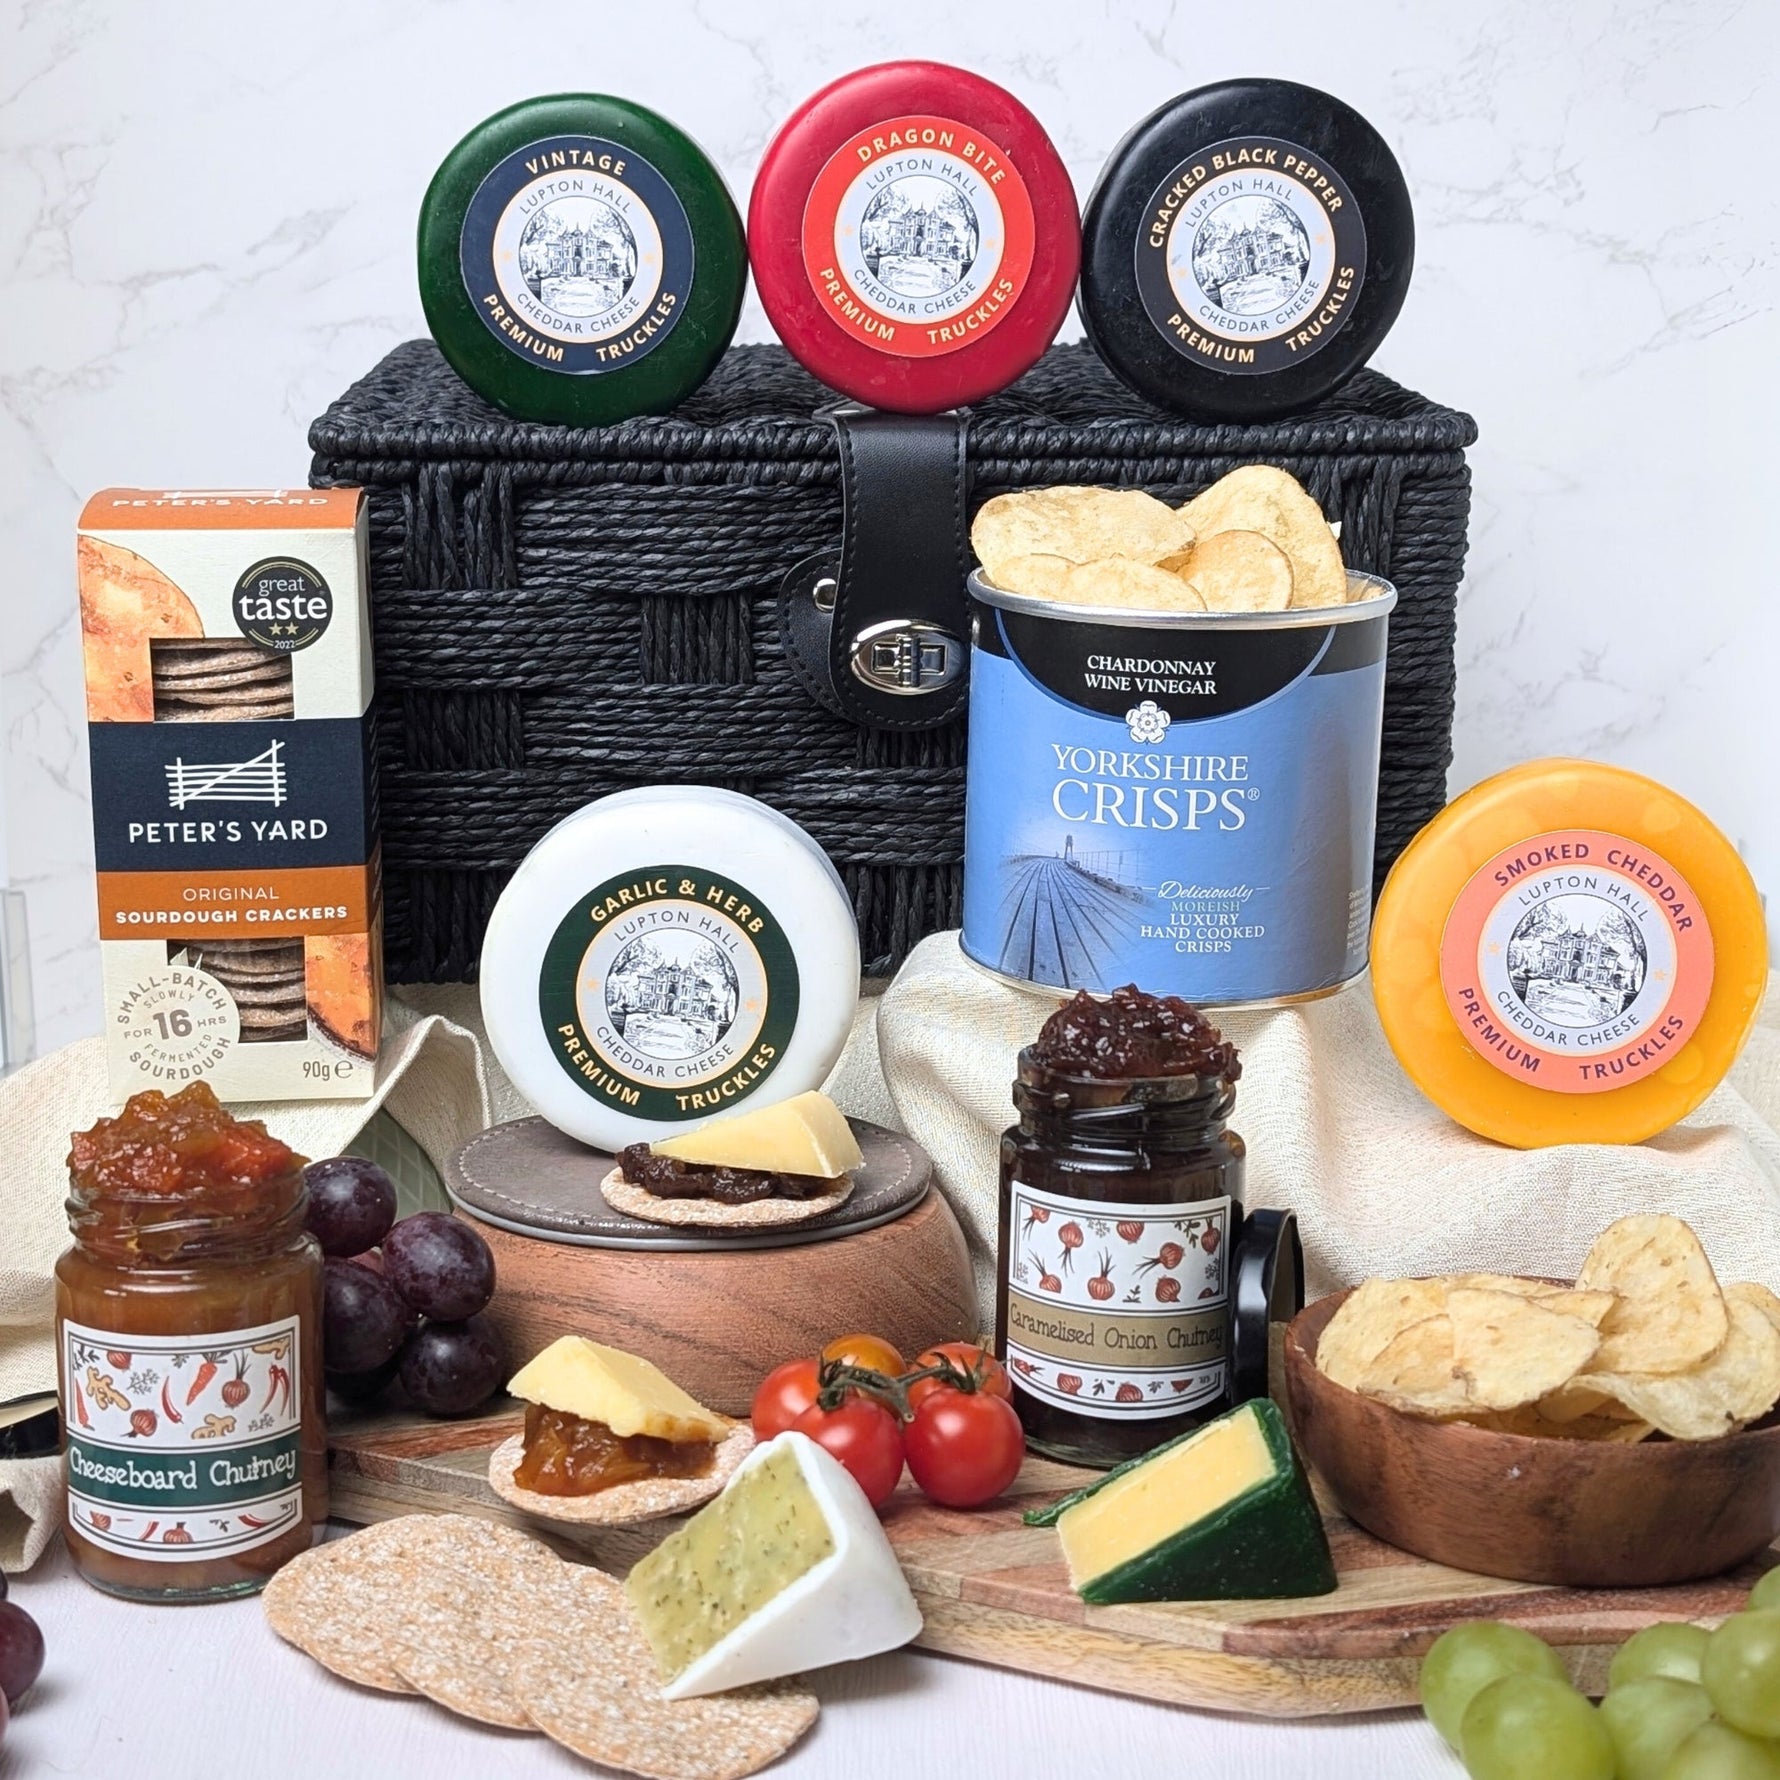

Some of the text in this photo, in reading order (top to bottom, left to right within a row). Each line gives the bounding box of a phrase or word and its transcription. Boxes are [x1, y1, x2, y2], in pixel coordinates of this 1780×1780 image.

[525, 150, 626, 176] VINTAGE
[857, 129, 1007, 185] DRAGON BITE
[520, 180, 631, 214] LUPTON HALL
[866, 159, 978, 197] LUPTON HALL
[1150, 148, 1343, 248] CRACKED BLACK PEPPER
[1185, 178, 1292, 228] LUPTON HALL
[820, 268, 1013, 344] PREMIUM TRUCKLES
[854, 269, 976, 314] CHEDDAR CHEESE
[1199, 279, 1319, 332] CHEDDAR CHEESE
[484, 293, 676, 362] PREMIUM TRUCKLES
[517, 293, 640, 334] CHEDDAR CHEESE
[1167, 267, 1354, 363] PREMIUM TRUCKLES
[112, 497, 328, 507] PETER'S YARD
[259, 577, 305, 596] great
[239, 594, 327, 621] taste
[274, 639, 296, 649] 2022
[1084, 673, 1217, 695] WINE VINEGAR
[1087, 655, 1216, 676] CHARDONNAY
[1051, 744, 1249, 782] YORKSHIRE
[129, 819, 328, 843] PETER'S YARD
[183, 887, 280, 901] ORIGINAL
[590, 879, 764, 933] GARLIC & HERB
[1158, 880, 1253, 902] Deliciously
[1171, 901, 1240, 912] MOREISH
[1494, 843, 1692, 932] SMOKED CHEDDAR
[1518, 876, 1649, 922] LUPTON HALL
[116, 906, 348, 924] SOURDOUGH CRACKERS
[614, 910, 739, 953] LUPTON HALL
[1140, 925, 1265, 939] HAND COOKED
[1170, 913, 1239, 926] LUXURY
[1175, 940, 1232, 953] CRISPS
[117, 972, 227, 1025] SMALL-BATCH
[143, 990, 195, 1009] SLOWLY
[1497, 990, 1639, 1046] CHEDDAR CHEESE
[124, 1009, 227, 1040] FOR 16 HRS
[1458, 988, 1684, 1080] PREMIUM TRUCKLES
[130, 1037, 231, 1080] SOURDOUGH
[144, 1034, 212, 1063] FERMENTED
[558, 1023, 775, 1111] PREMIUM TRUCKLES
[597, 1026, 734, 1078] CHEDDAR CHEESE
[1010, 1303, 1223, 1349] Caramelised Onion Chutney
[69, 1446, 296, 1490] Cheeseboard Chutney
